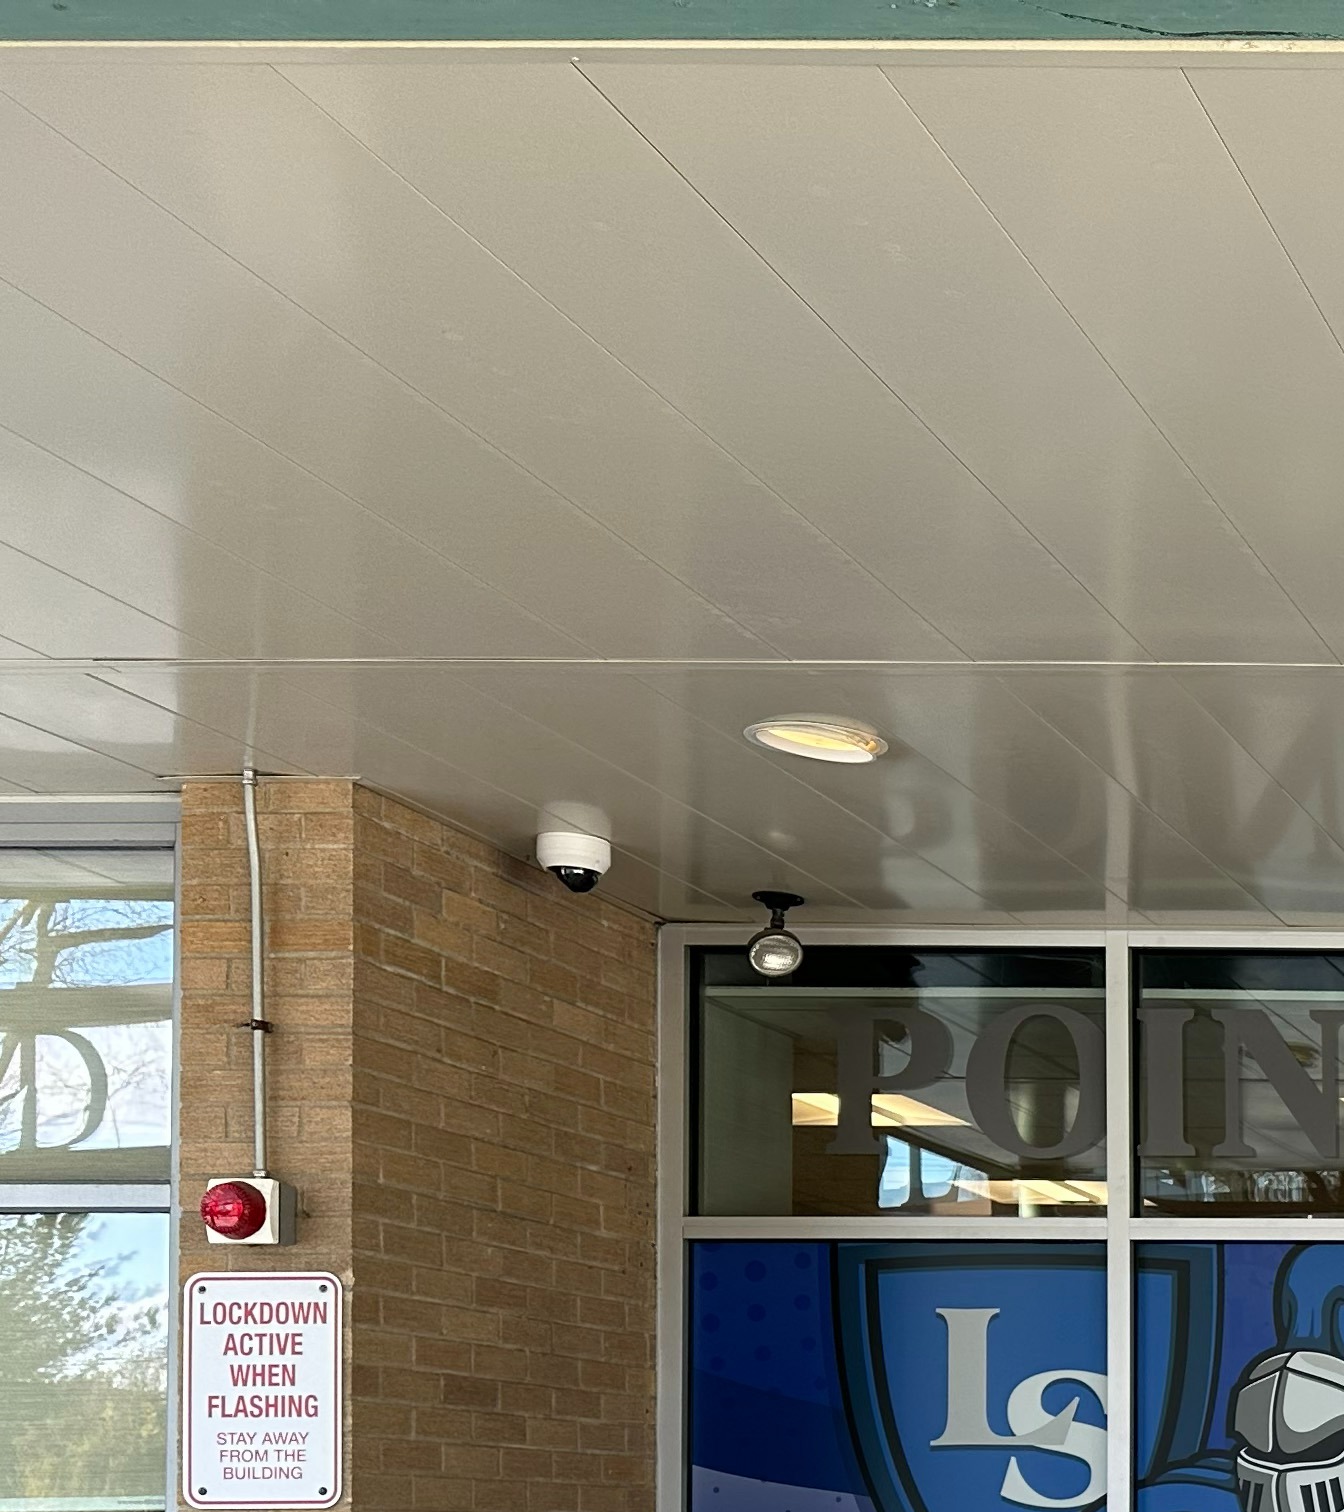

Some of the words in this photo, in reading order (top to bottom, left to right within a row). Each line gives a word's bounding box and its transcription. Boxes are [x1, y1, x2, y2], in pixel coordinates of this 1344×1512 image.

[199, 1301, 328, 1326] LOCKDOWN
[222, 1332, 304, 1356] ACTIVE
[229, 1363, 297, 1387] WHEN
[207, 1394, 319, 1418] FLASHING
[929, 1306, 1107, 1510] LS
[216, 1431, 258, 1446] STAY
[261, 1431, 310, 1446] AWAY
[219, 1449, 269, 1463] FROM
[273, 1449, 307, 1463] THE
[222, 1466, 304, 1480] BUILDING
